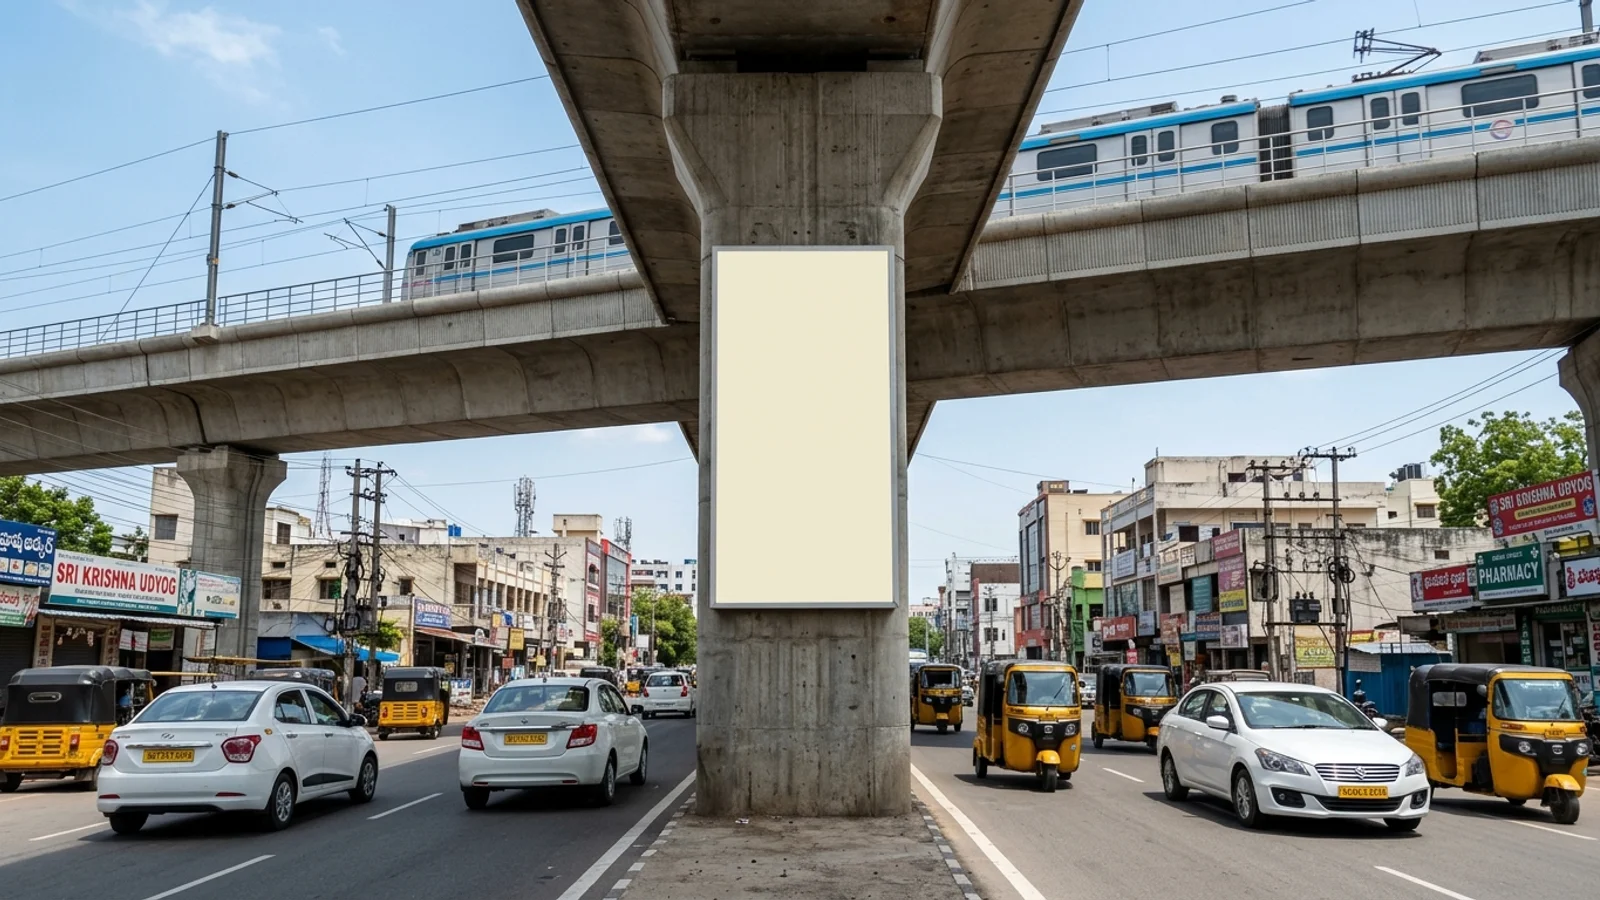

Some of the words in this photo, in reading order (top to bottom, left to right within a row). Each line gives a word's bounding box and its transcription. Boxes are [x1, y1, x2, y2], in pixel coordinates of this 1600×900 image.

[1499, 496, 1514, 511] SRI
[56, 562, 79, 585] SRI
[82, 566, 136, 591] KRISHNA
[140, 573, 177, 595] UDYOG
[1479, 561, 1539, 585] PHARMACY
